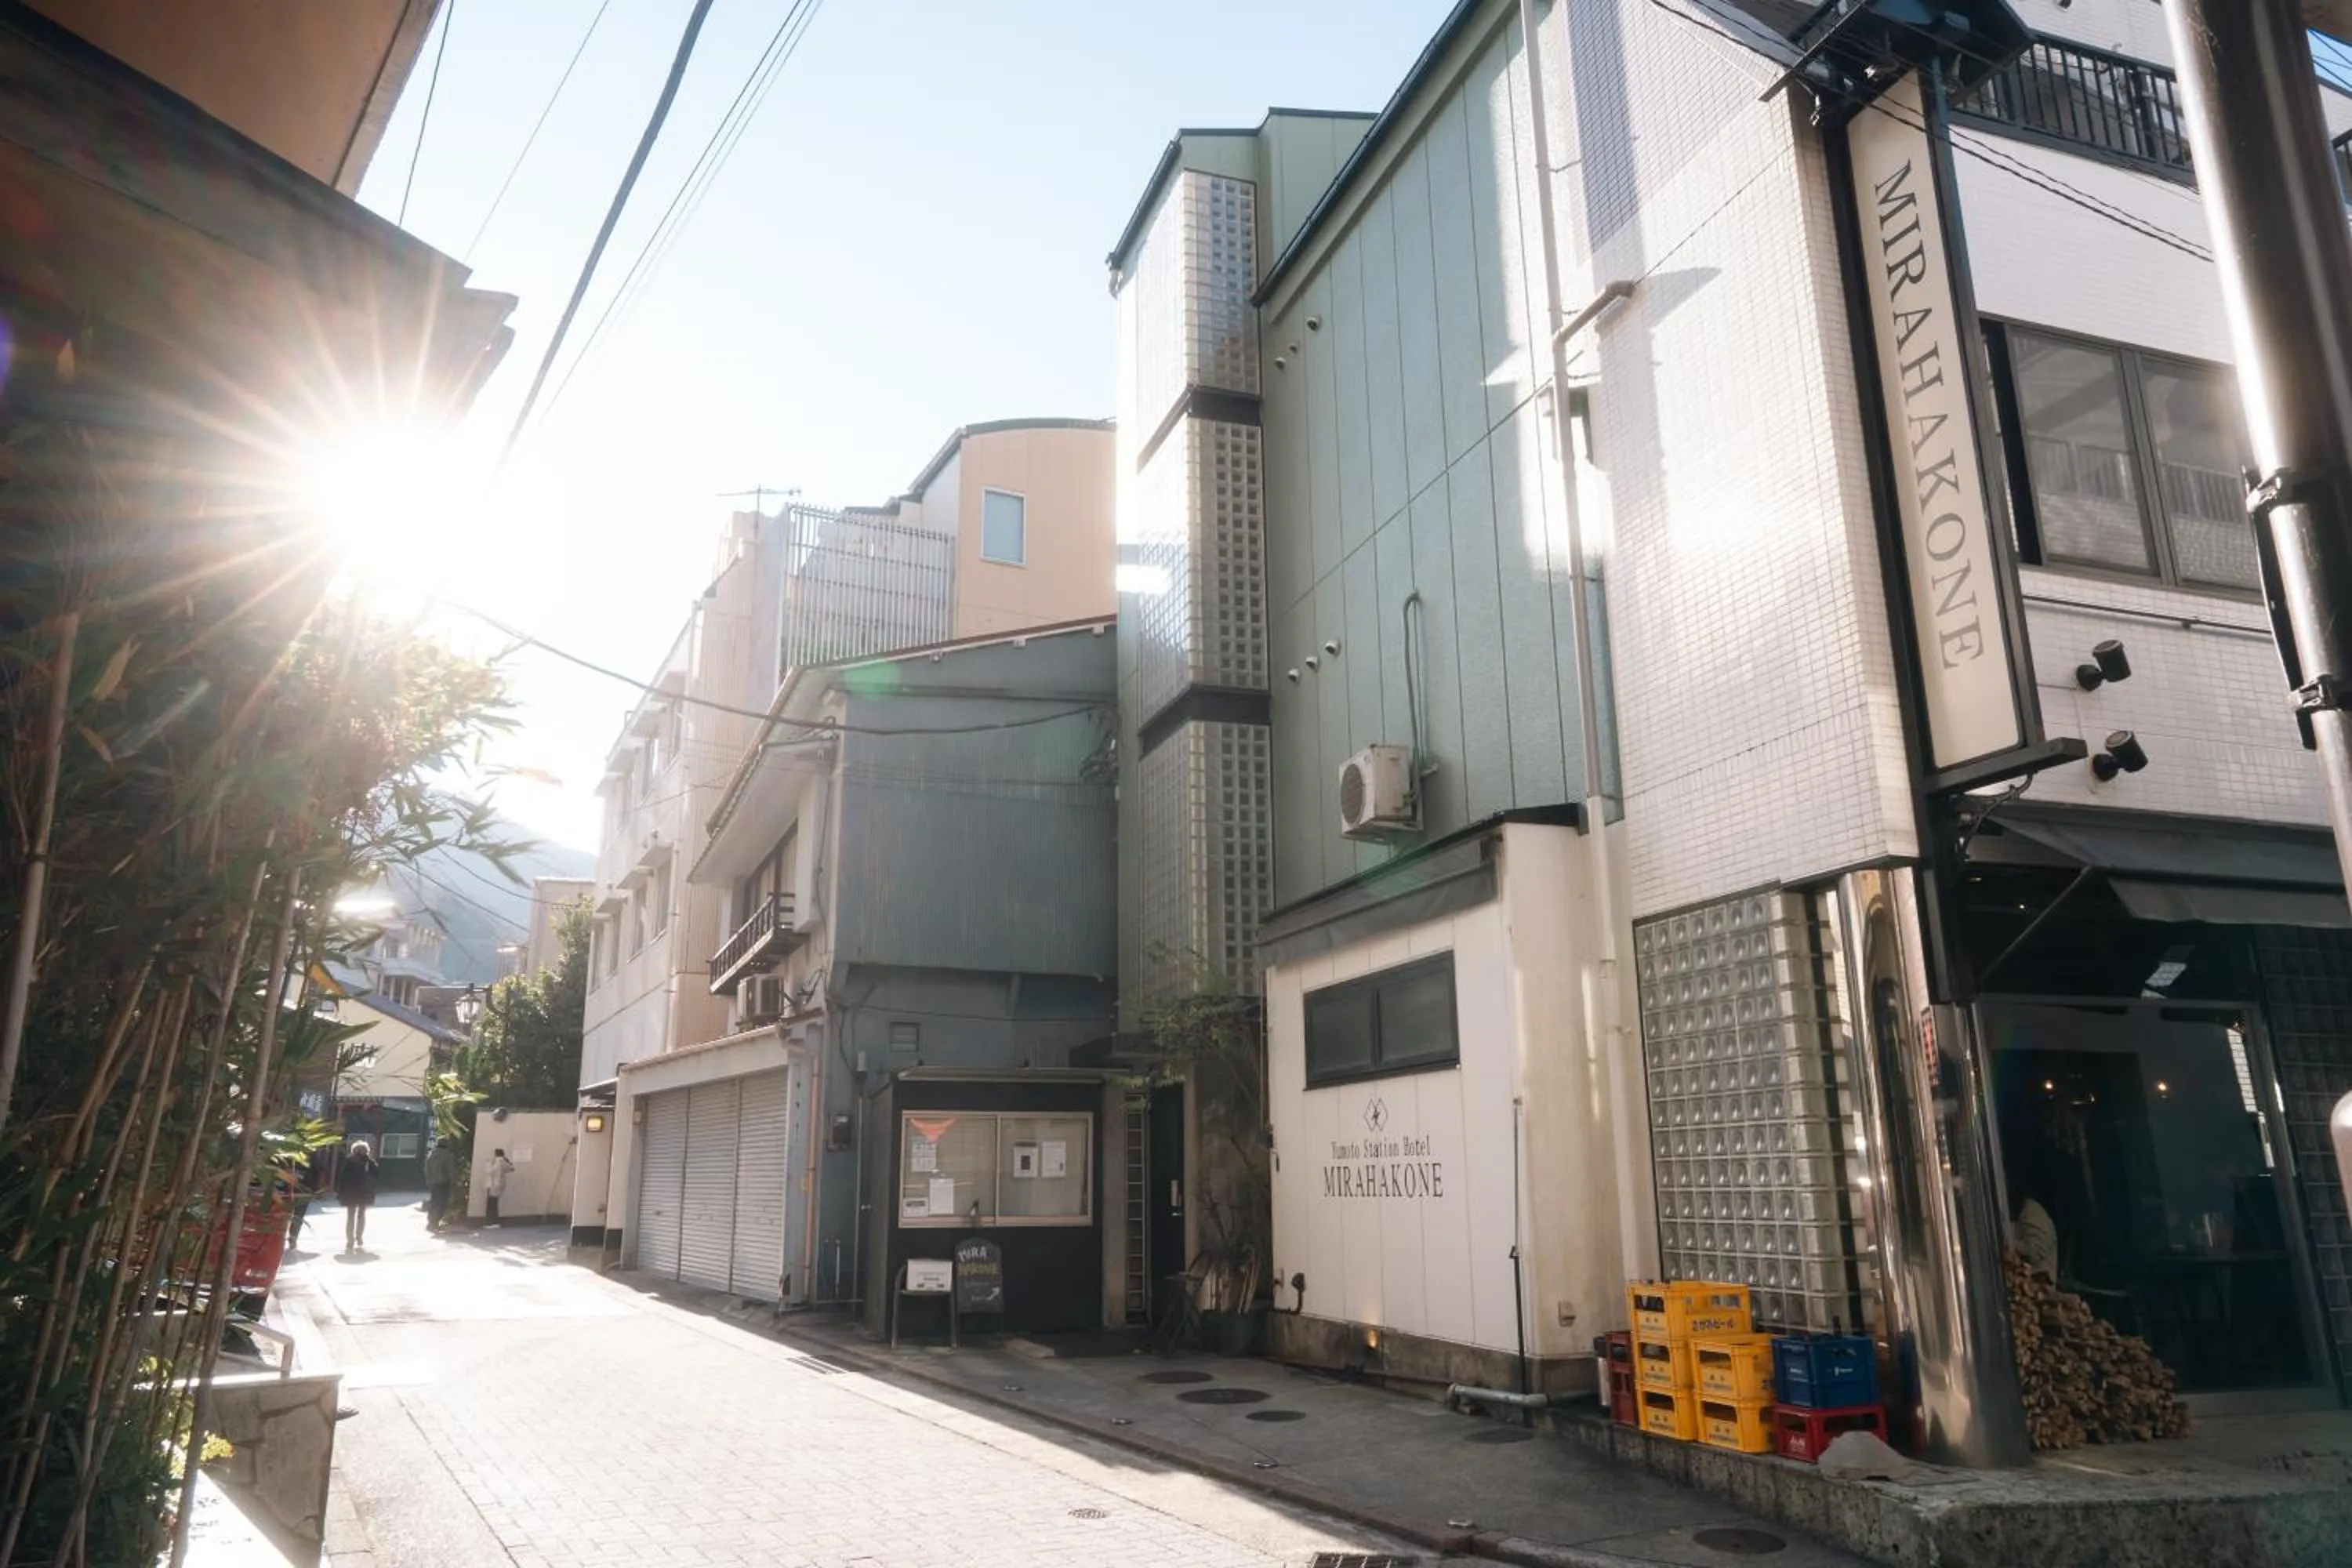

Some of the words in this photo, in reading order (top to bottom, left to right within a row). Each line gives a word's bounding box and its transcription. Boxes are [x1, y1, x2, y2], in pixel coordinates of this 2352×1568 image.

[1874, 158, 1985, 671] MIRAHAKONE
[1363, 1136, 1399, 1160] Station
[1403, 1134, 1431, 1158] Hotel
[1323, 1162, 1443, 1199] MIRAHAKONE
